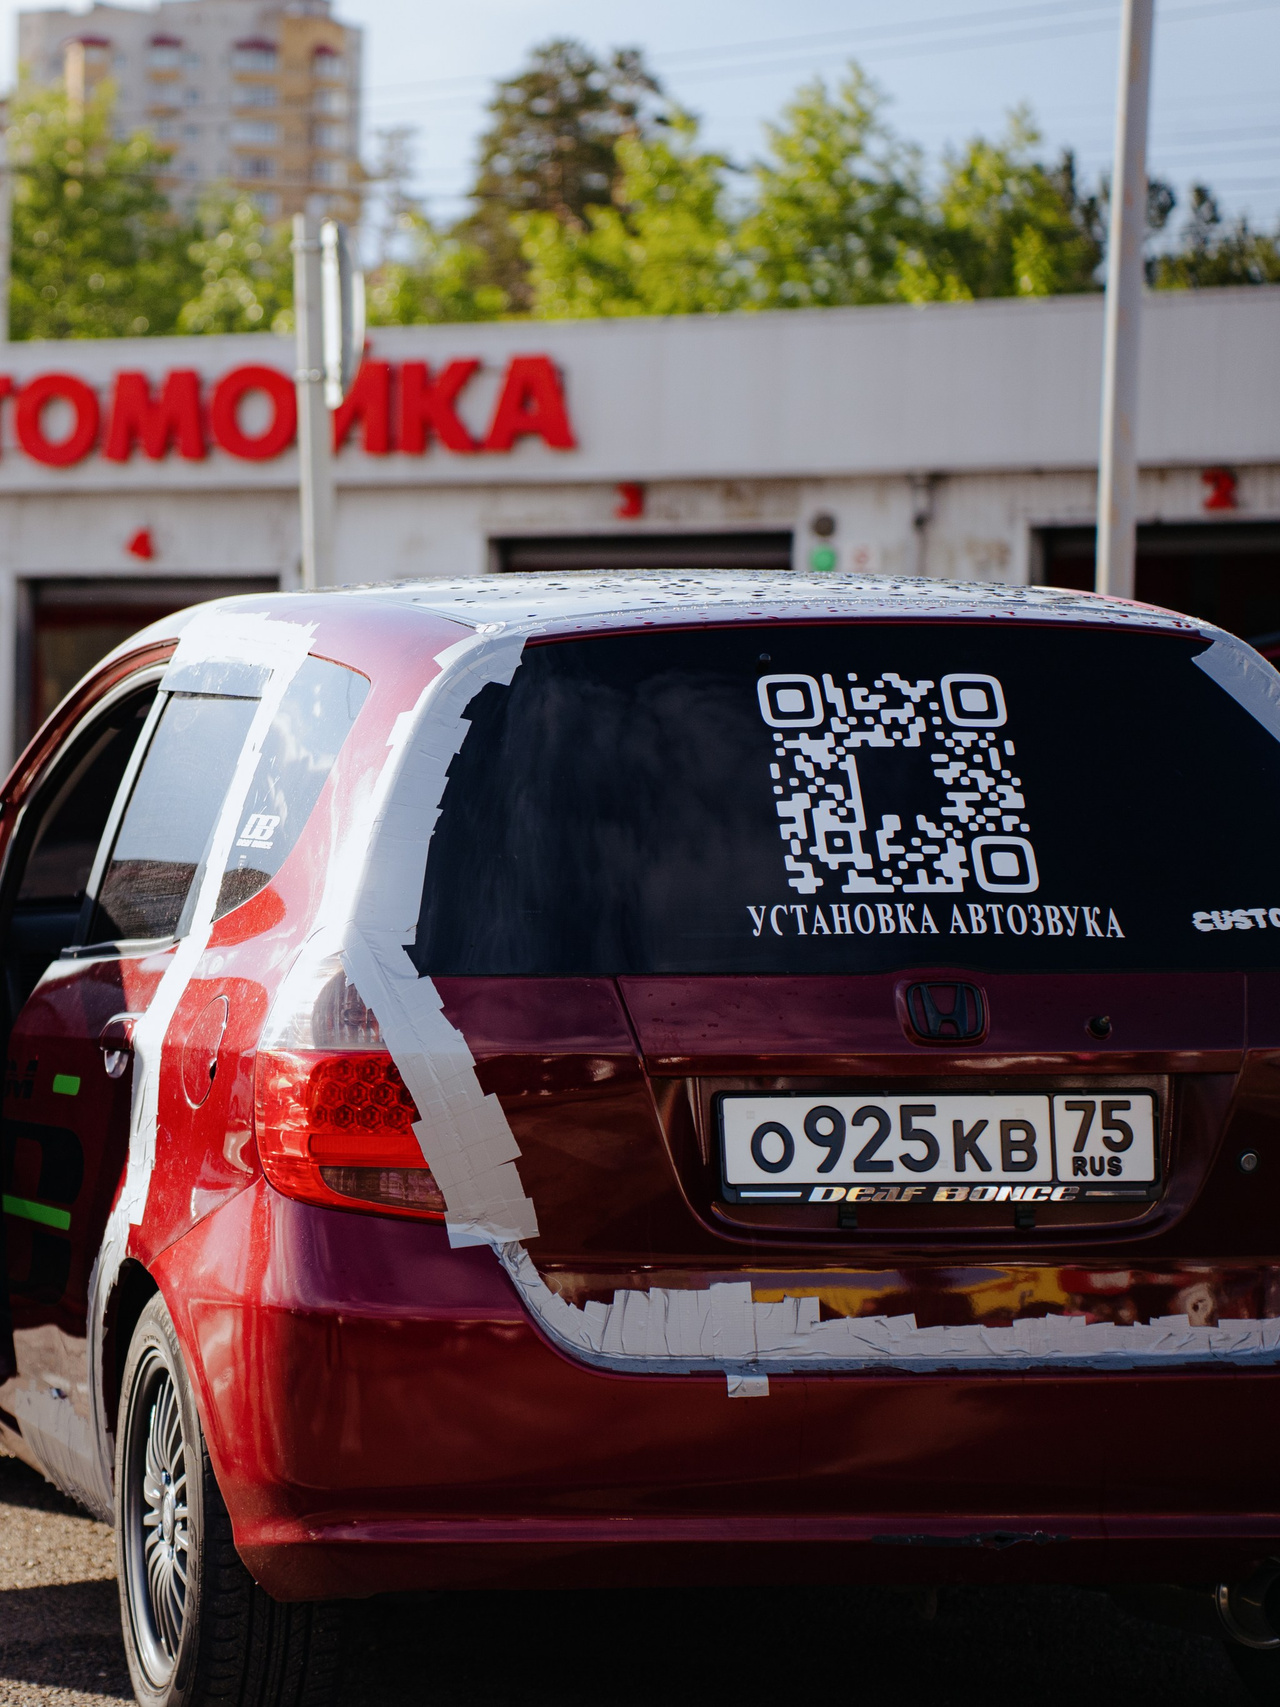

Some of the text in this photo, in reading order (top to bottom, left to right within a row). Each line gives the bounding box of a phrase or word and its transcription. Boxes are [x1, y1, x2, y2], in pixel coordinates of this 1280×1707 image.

[1202, 467, 1237, 511] 2
[747, 903, 1126, 938] УСТАНОВКА АВТОЗВУКА
[1065, 1100, 1134, 1153] 75
[1072, 1155, 1124, 1177] RUS
